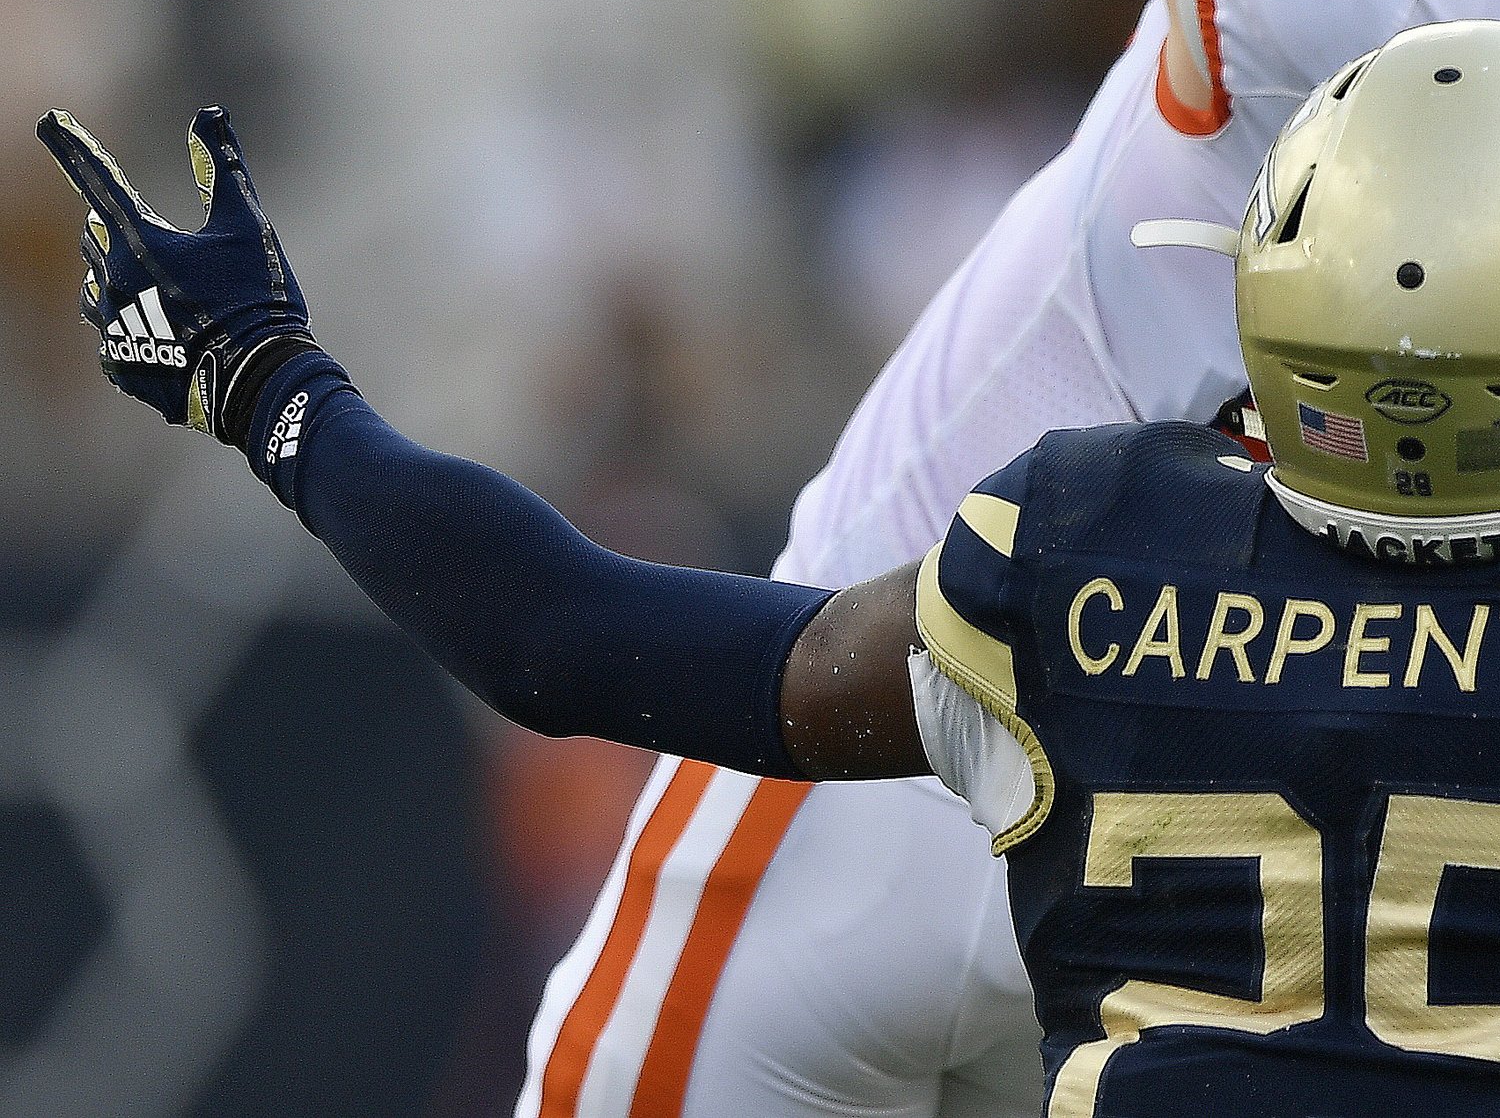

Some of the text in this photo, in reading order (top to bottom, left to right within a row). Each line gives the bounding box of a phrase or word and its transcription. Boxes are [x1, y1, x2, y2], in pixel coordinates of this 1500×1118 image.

[107, 335, 188, 368] adidas
[1378, 389, 1437, 408] ACC
[266, 391, 310, 465] adidas
